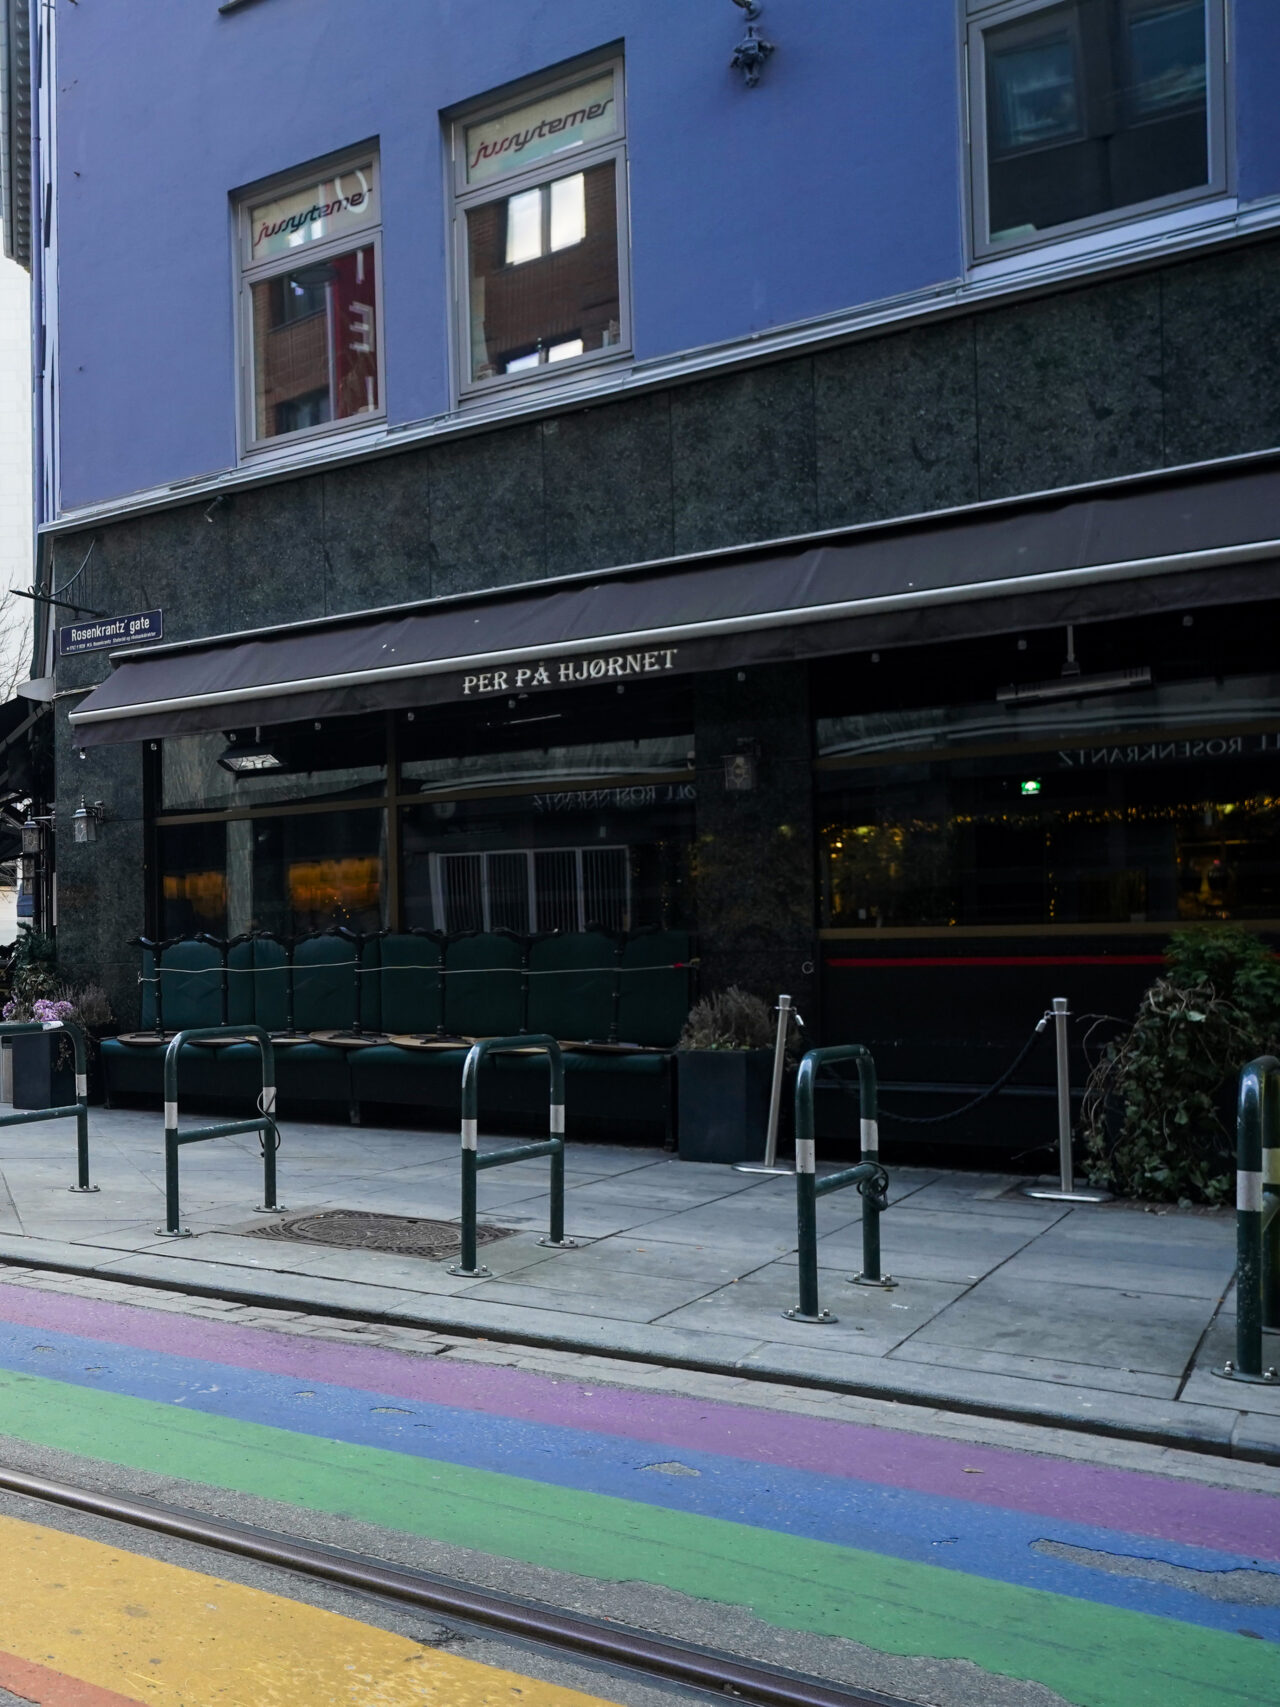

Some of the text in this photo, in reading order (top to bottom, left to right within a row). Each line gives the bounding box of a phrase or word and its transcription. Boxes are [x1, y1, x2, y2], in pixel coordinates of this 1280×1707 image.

[471, 99, 613, 169] jussystemer
[129, 617, 150, 634] gate
[462, 649, 678, 695] PER PÅ HJØRNET
